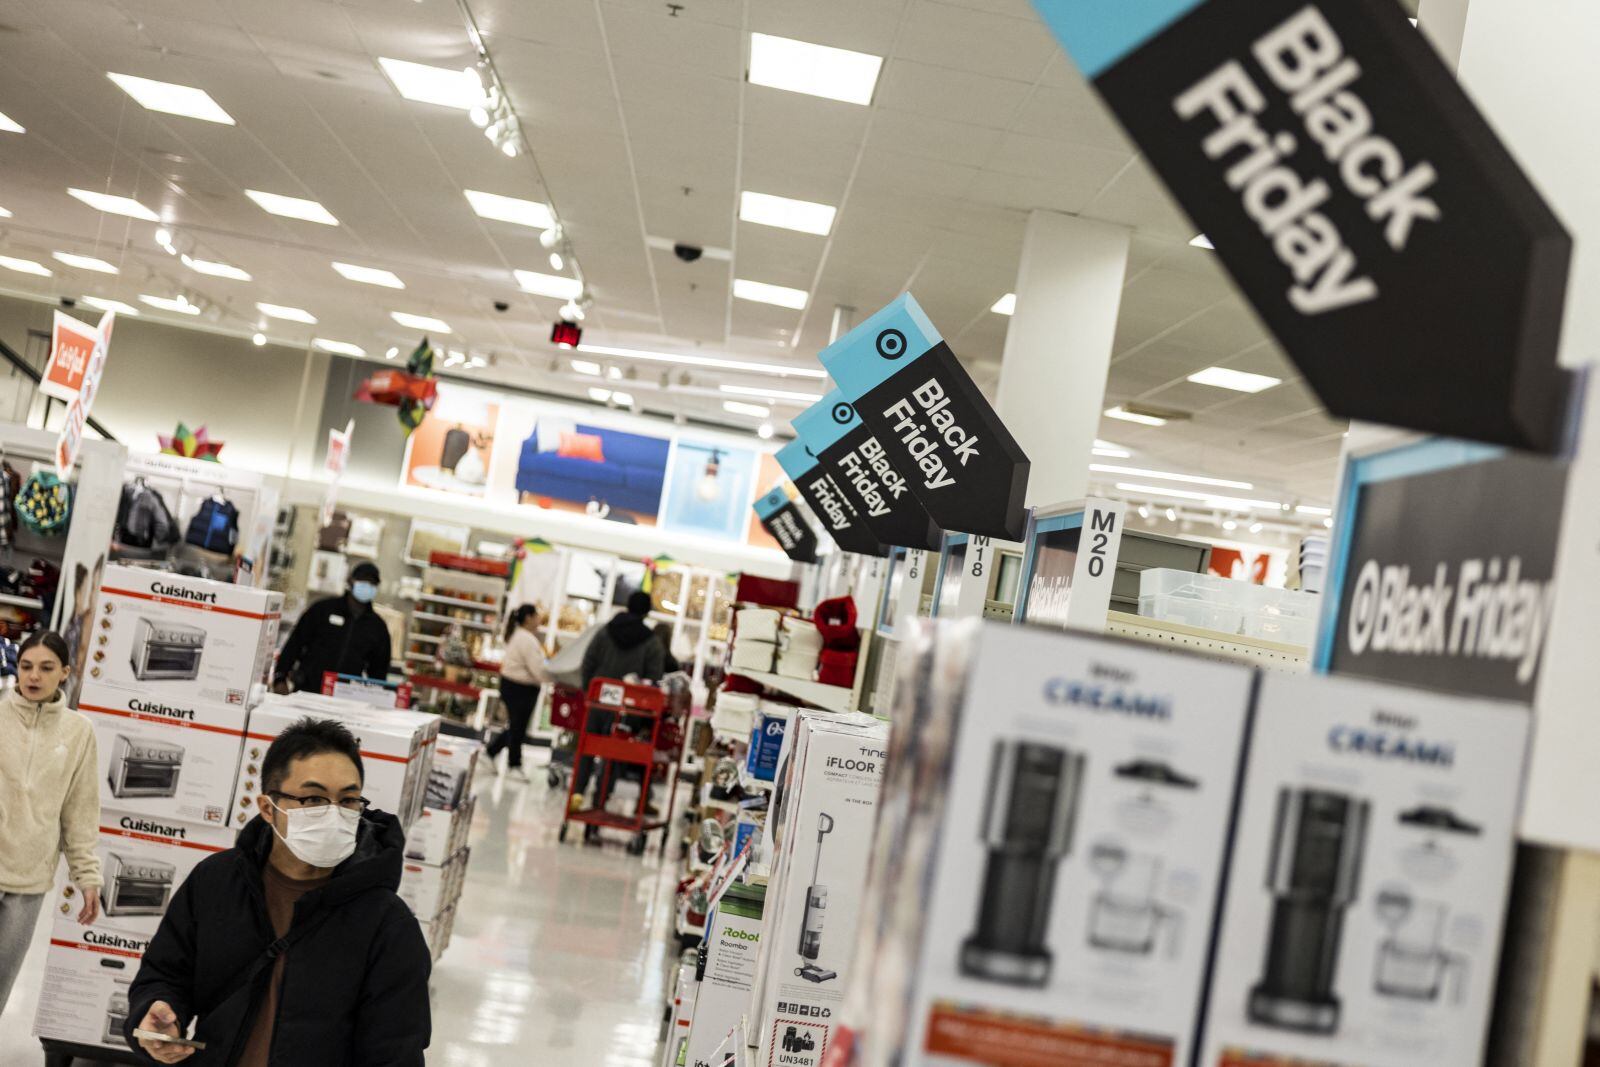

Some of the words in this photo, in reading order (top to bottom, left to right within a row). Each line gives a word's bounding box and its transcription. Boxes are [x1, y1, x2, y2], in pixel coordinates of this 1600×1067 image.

[1251, 5, 1442, 252] Black
[1172, 59, 1379, 315] Friday
[883, 398, 956, 490] Friday
[912, 378, 980, 466] Black
[838, 451, 892, 518] Friday
[858, 436, 909, 500] Black
[809, 477, 851, 531] Friday
[1088, 509, 1115, 577] M20
[151, 582, 216, 603] Cuisinart
[1371, 564, 1452, 656] Black
[1448, 556, 1554, 684] Friday
[128, 699, 194, 720] Cuisinart
[826, 756, 875, 773] iFLOOR
[120, 816, 186, 838] Cuisinart
[720, 940, 748, 950] Roomba
[723, 927, 760, 942] iRobot
[779, 1055, 814, 1066] UN3481
